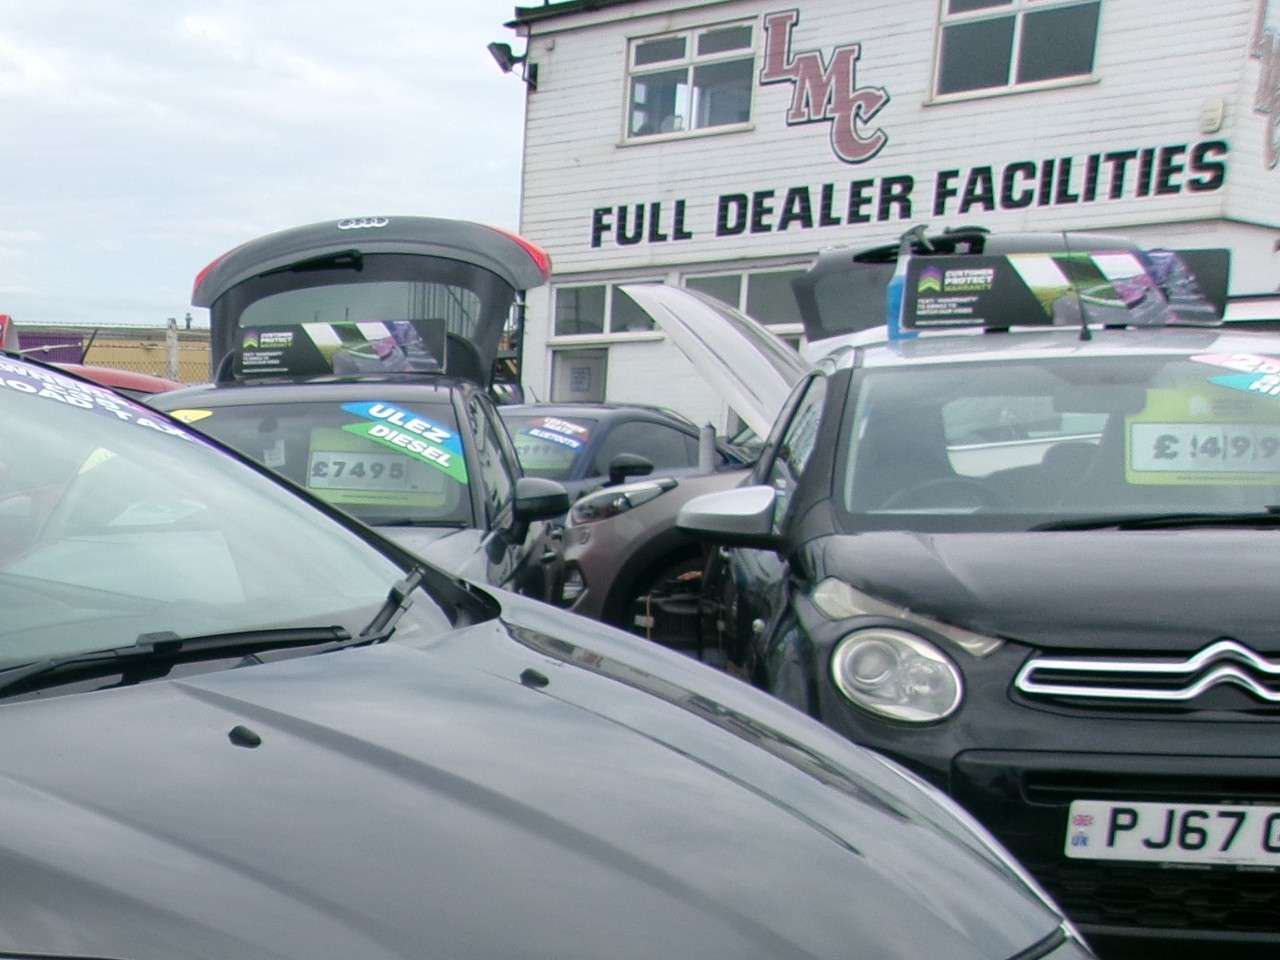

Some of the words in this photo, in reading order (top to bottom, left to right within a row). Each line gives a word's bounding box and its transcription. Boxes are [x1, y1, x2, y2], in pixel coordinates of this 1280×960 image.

[760, 8, 891, 165] LMC
[591, 200, 692, 248] FULL
[716, 174, 915, 235] DEALER
[932, 140, 1229, 216] FACILITIES
[368, 403, 452, 443] ULEZ
[367, 424, 452, 468] DIESEL
[311, 460, 405, 480] £7495
[1106, 806, 1247, 852] PJ67
